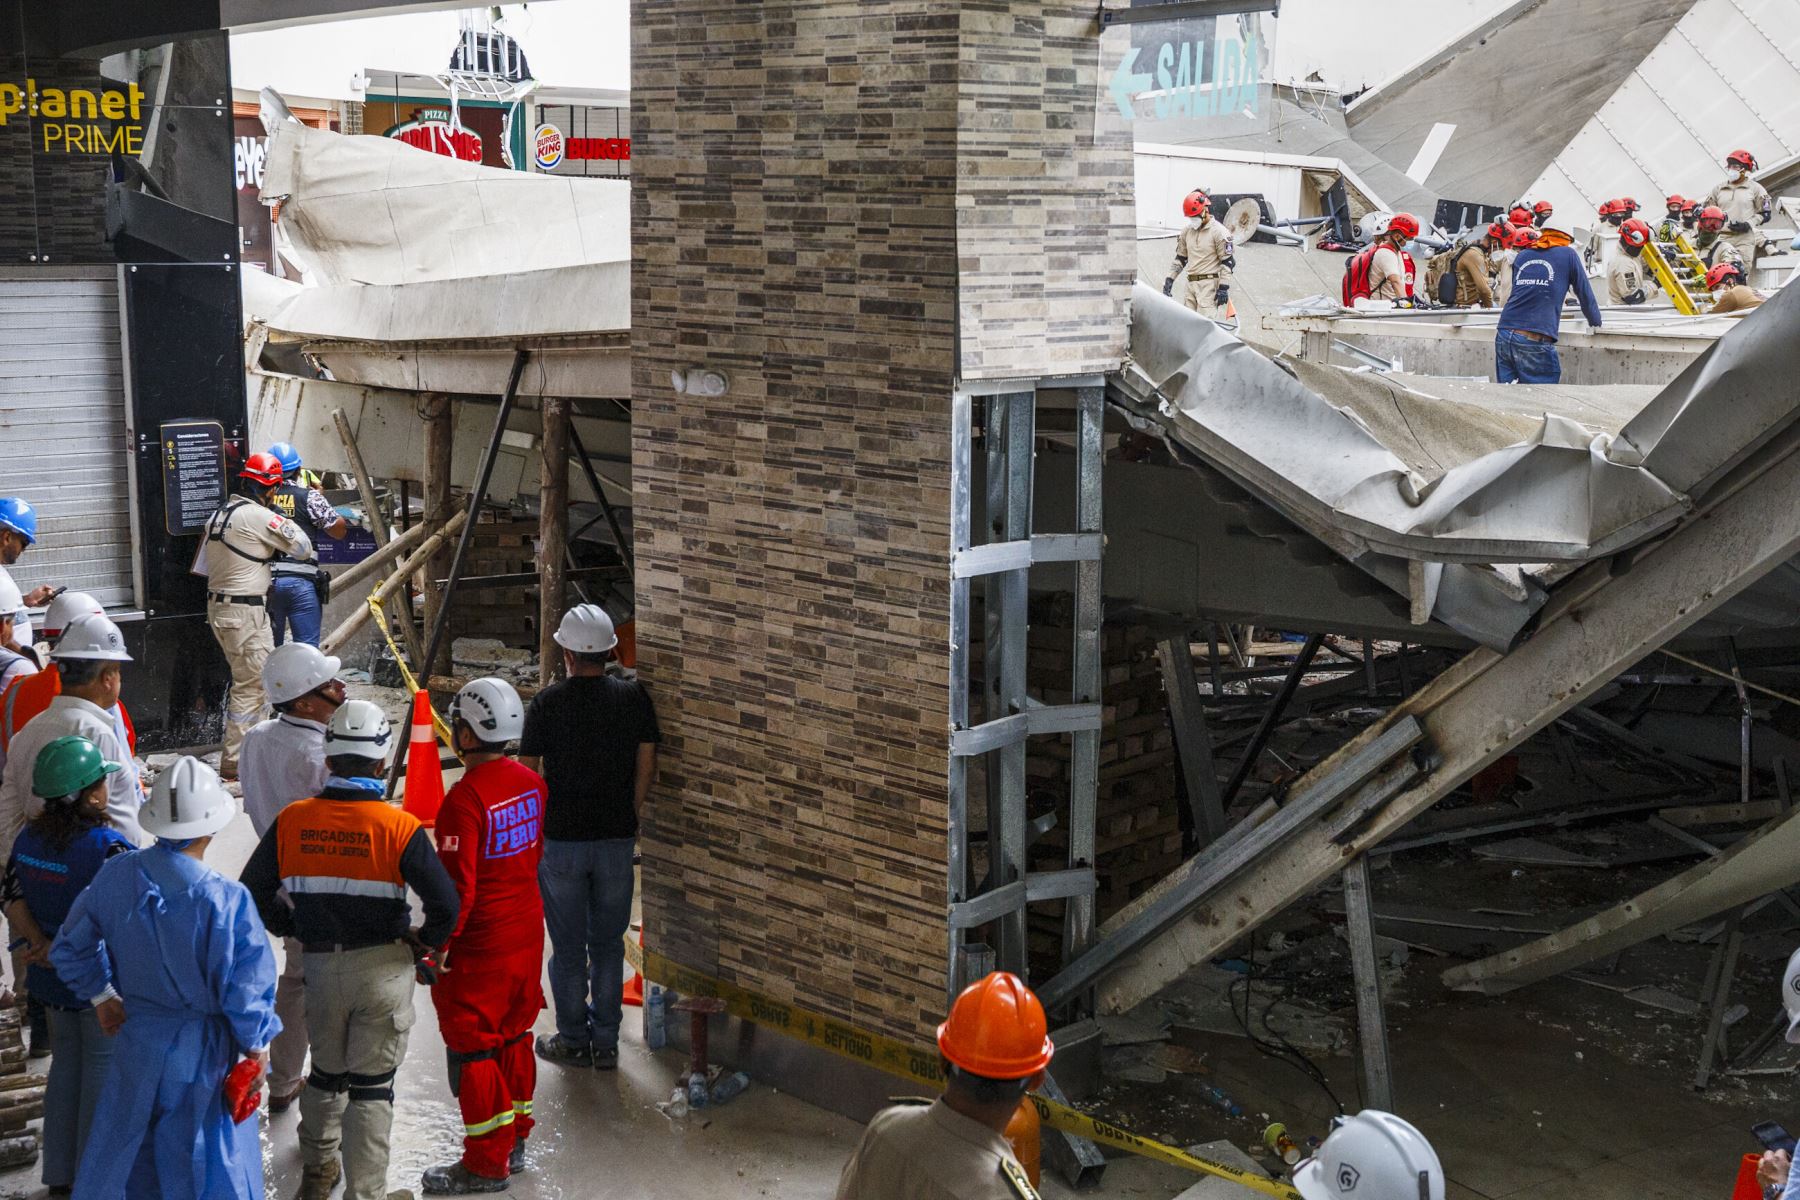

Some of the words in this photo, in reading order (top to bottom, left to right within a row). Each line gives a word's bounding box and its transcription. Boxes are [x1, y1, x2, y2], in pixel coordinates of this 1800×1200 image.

[1155, 34, 1259, 120] SALIDA
[0, 79, 145, 126] planet
[424, 109, 448, 120] PIZZA
[43, 123, 143, 154] PRIME
[536, 133, 560, 148] BURGER
[537, 141, 561, 159] KING
[494, 797, 538, 830] USAR
[301, 829, 370, 845] BRIGADISTA
[495, 819, 538, 852] PERU
[327, 845, 337, 855] LA
